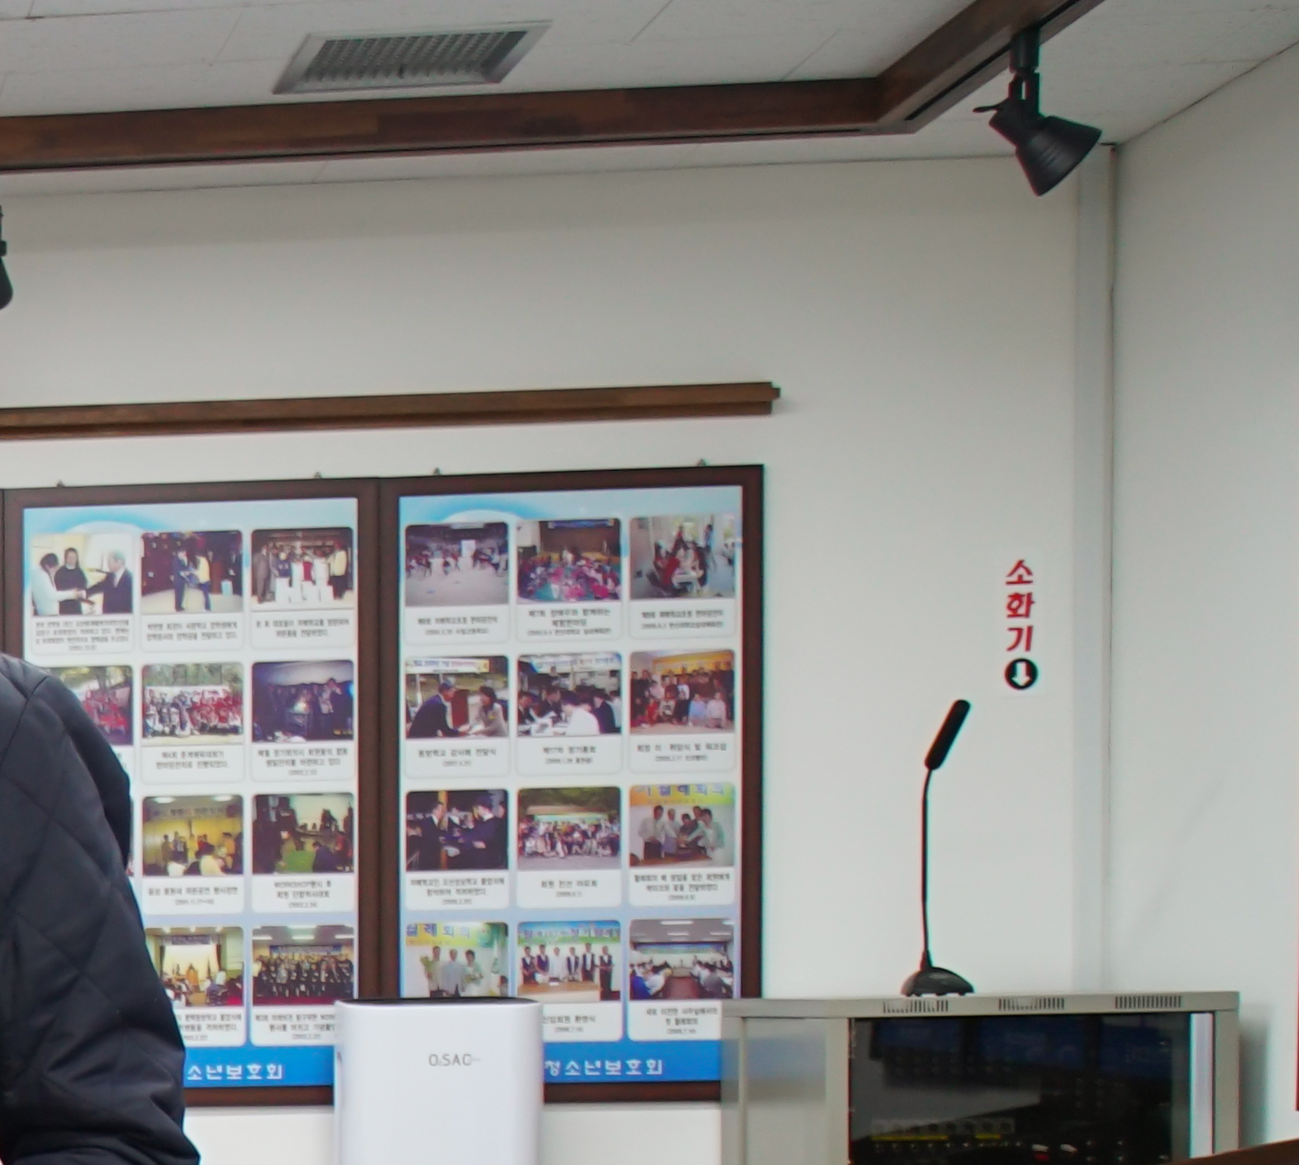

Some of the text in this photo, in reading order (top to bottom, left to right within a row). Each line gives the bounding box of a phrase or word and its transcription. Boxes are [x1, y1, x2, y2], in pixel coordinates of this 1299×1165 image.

[1005, 559, 1036, 653] 소화기
[187, 1064, 283, 1080] 소년보호회
[545, 1059, 663, 1076] 청소년보호회
